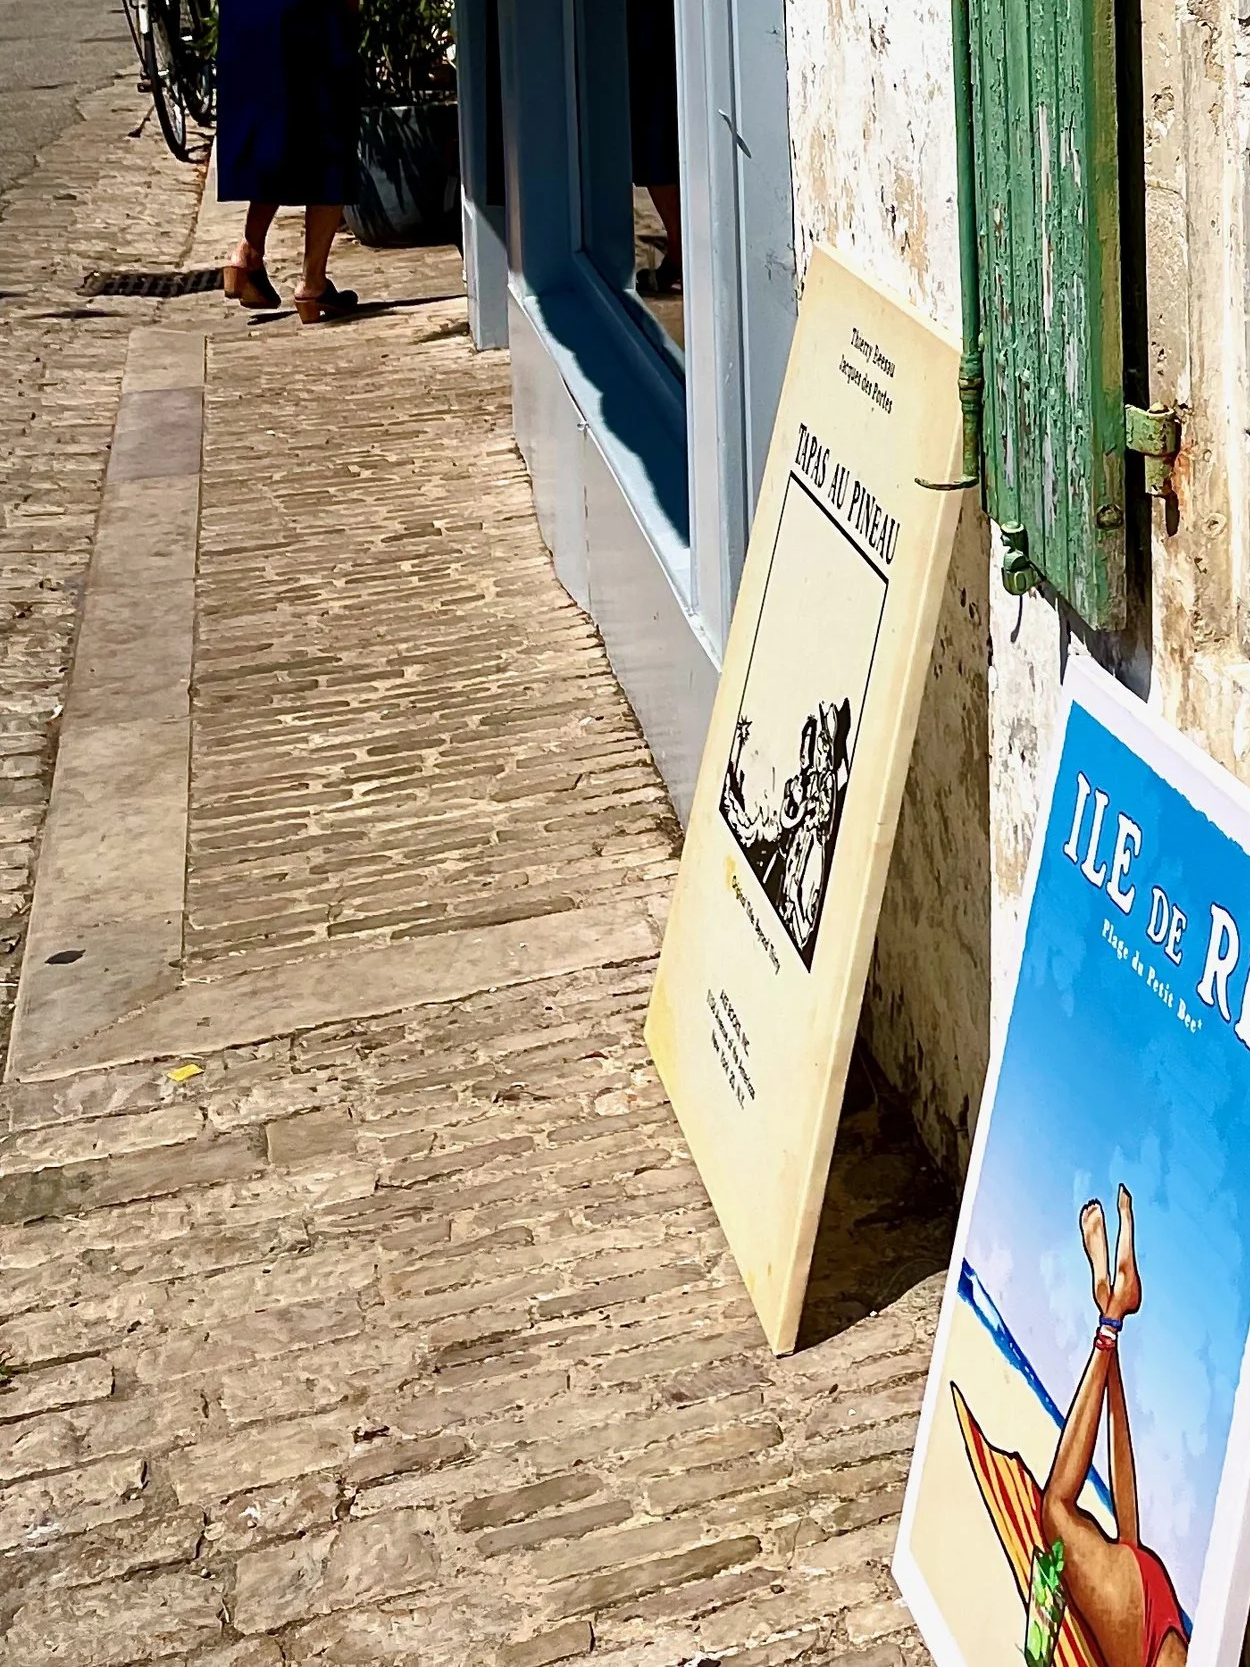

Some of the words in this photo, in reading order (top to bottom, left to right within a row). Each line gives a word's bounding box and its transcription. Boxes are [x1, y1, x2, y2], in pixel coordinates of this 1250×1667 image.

[795, 422, 830, 488] TAPAS
[827, 463, 850, 510] AU
[847, 480, 900, 565] PINEAU
[1062, 771, 1143, 915] ILE
[1146, 885, 1188, 967] DE
[1101, 918, 1129, 960] Plage
[1131, 950, 1144, 977] du
[1146, 965, 1174, 1008] Petit
